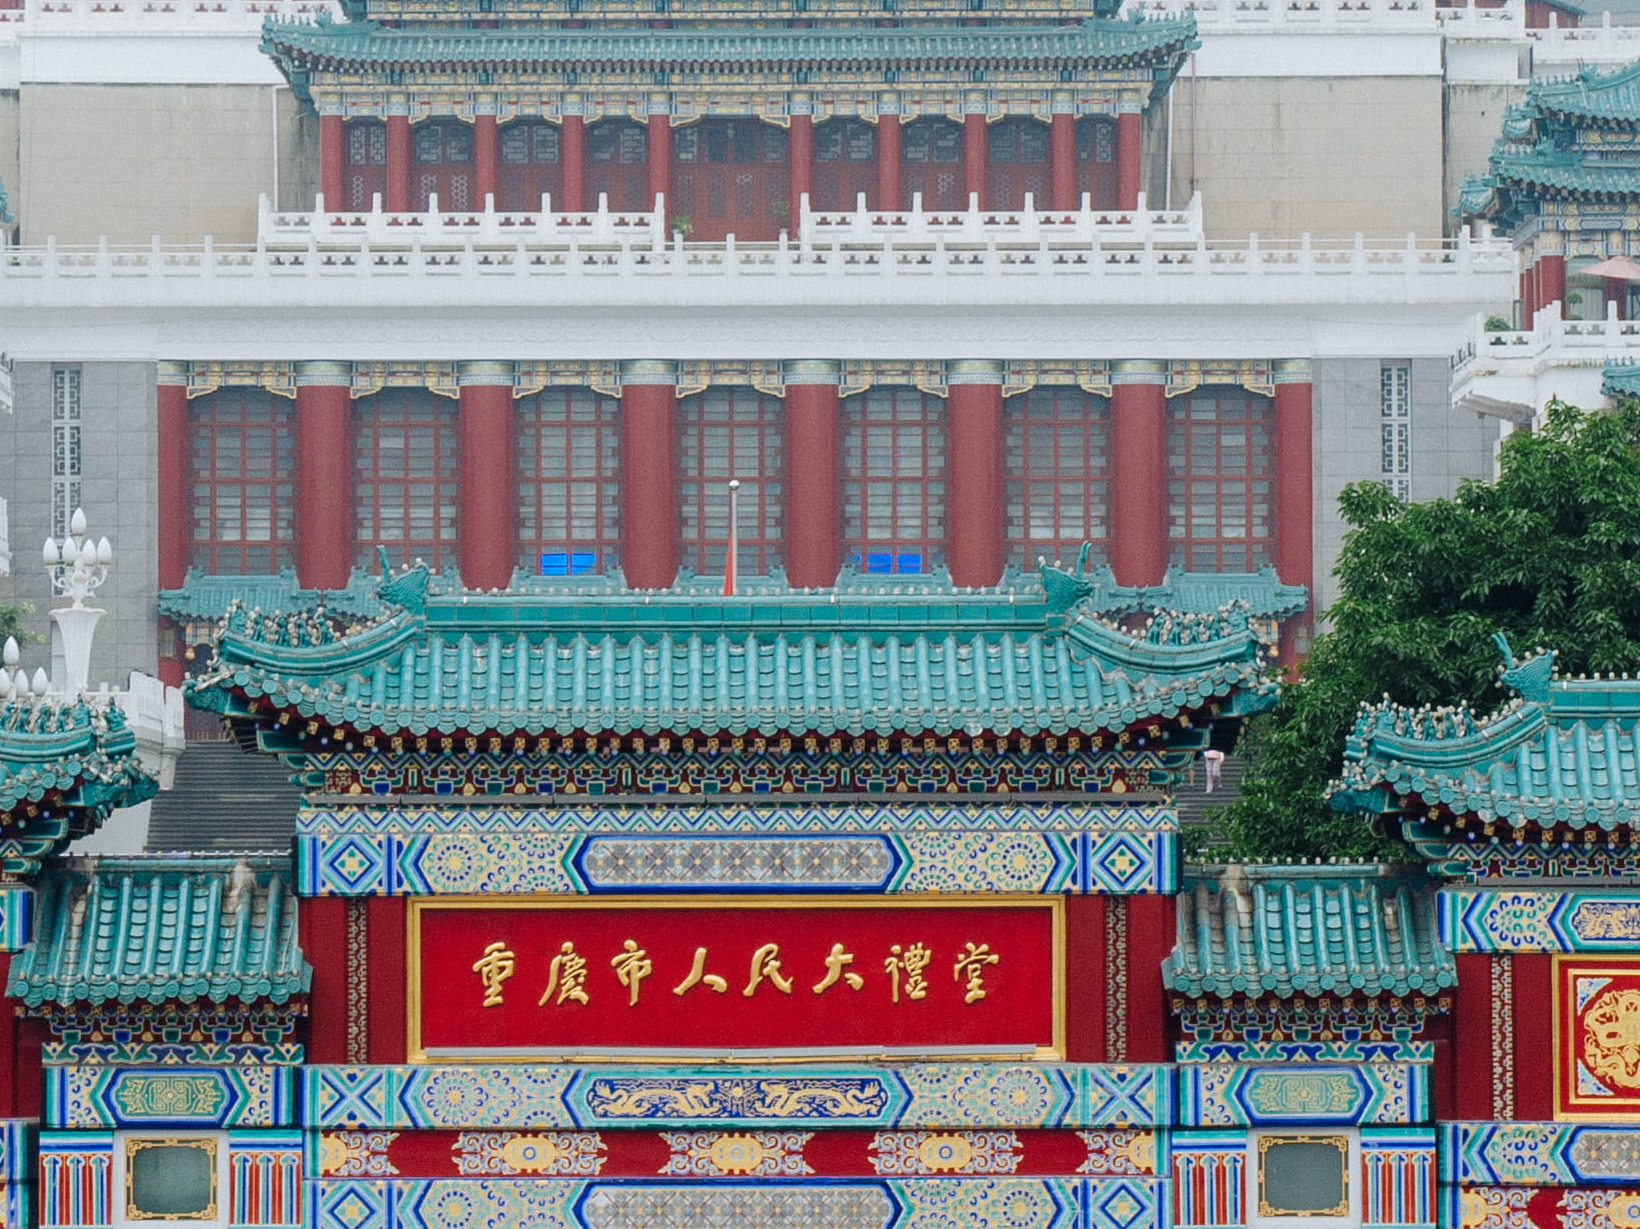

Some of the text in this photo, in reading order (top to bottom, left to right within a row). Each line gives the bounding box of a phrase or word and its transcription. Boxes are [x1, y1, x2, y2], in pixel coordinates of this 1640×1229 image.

[473, 940, 1000, 1007] 重慶市人民大禮堂
